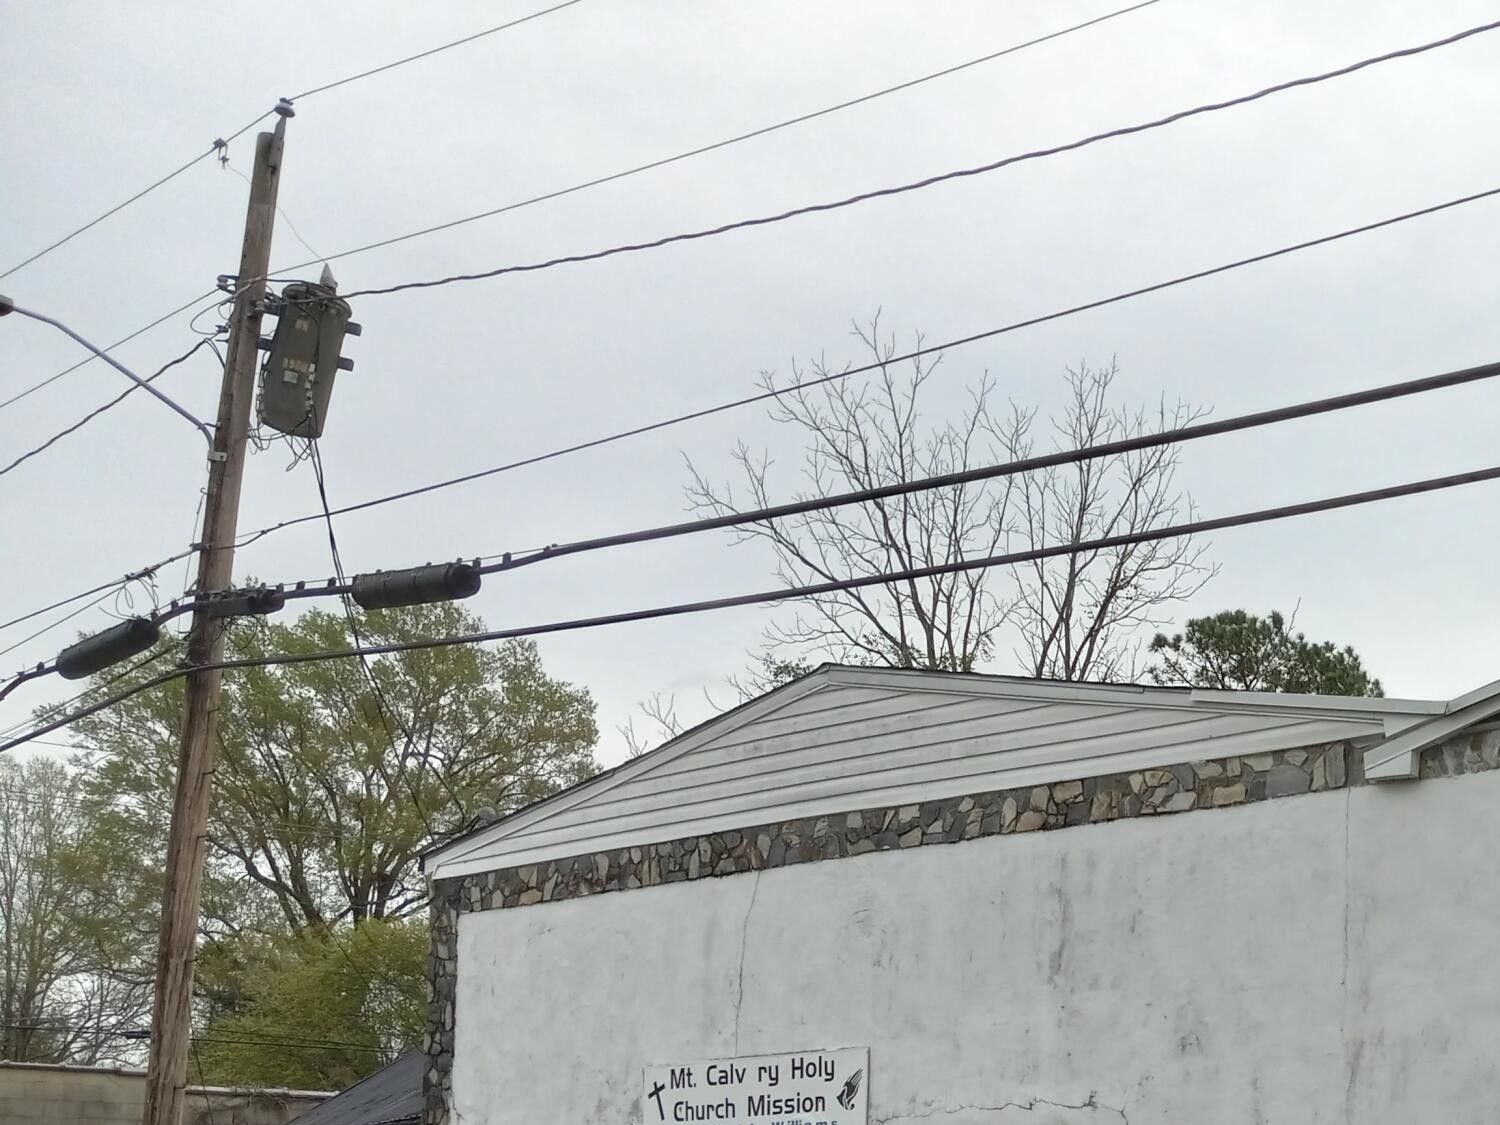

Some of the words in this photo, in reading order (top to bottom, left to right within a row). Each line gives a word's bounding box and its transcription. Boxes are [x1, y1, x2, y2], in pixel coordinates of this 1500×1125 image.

[670, 1067, 697, 1089] Mt.
[791, 1055, 835, 1082] Holy
[673, 1097, 736, 1122] Church
[747, 1091, 826, 1118] Mission
